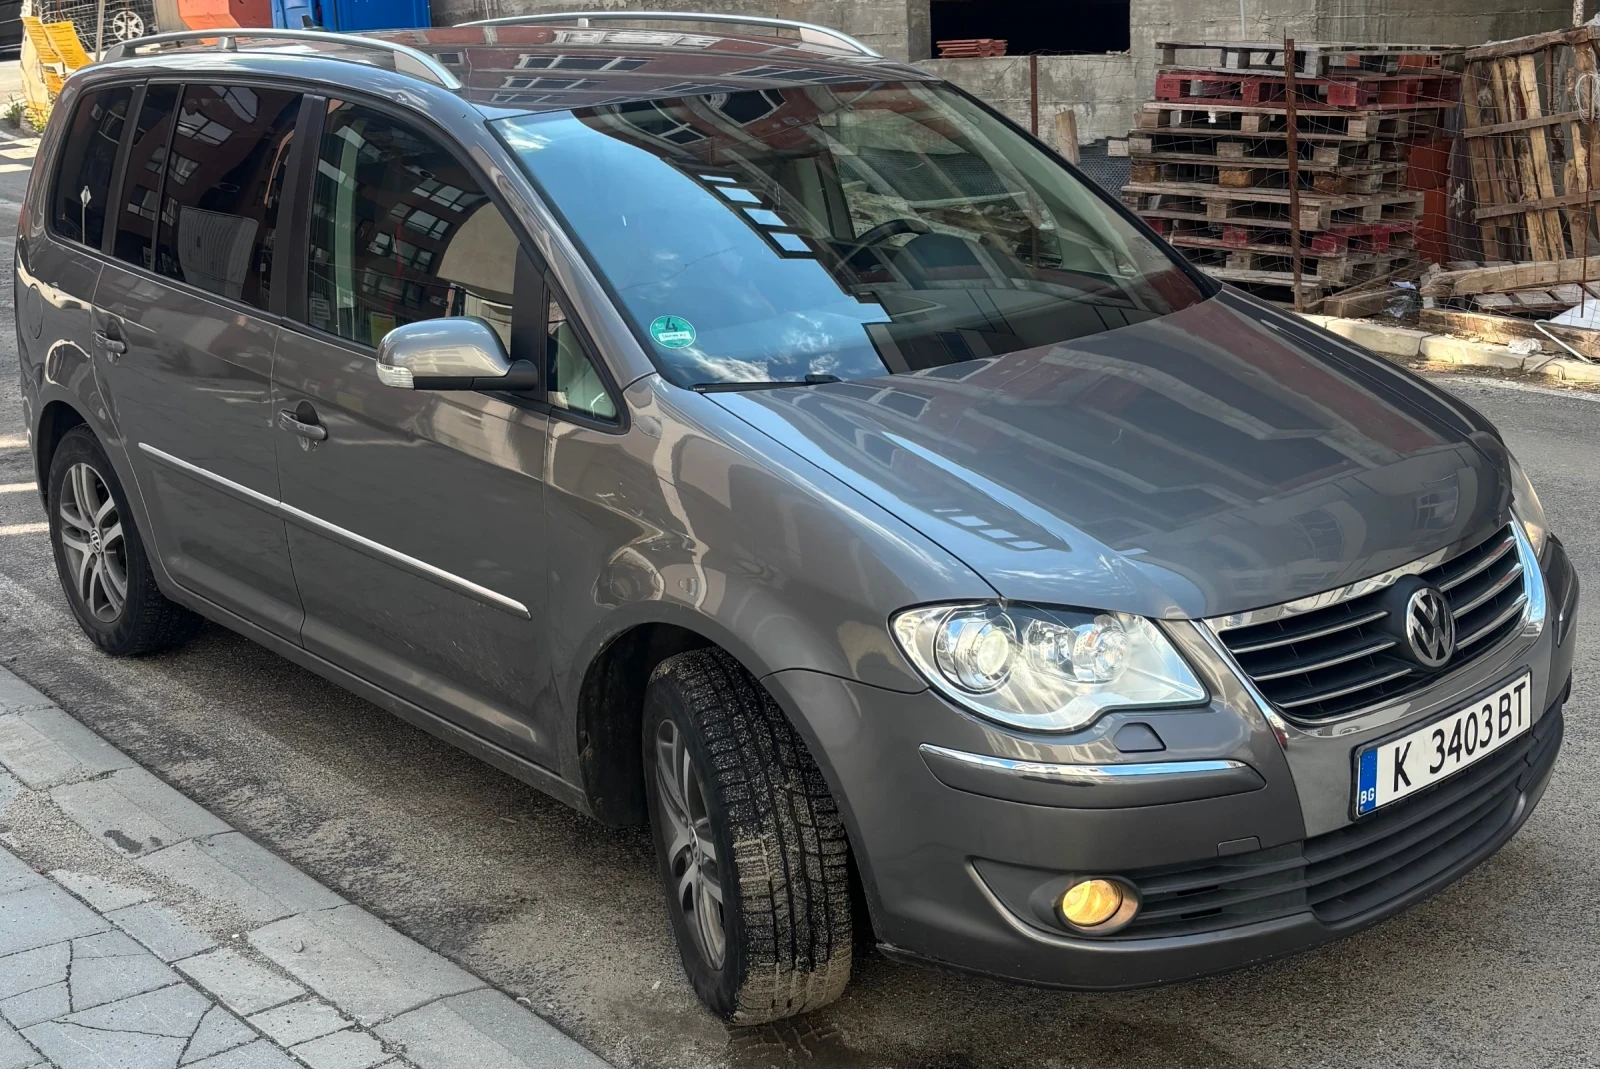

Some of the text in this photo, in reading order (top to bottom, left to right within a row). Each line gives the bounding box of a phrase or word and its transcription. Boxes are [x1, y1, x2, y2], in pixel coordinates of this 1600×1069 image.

[665, 317, 678, 332] 4
[1407, 588, 1455, 667] VW
[1393, 740, 1412, 793] K
[1360, 787, 1375, 804] BG
